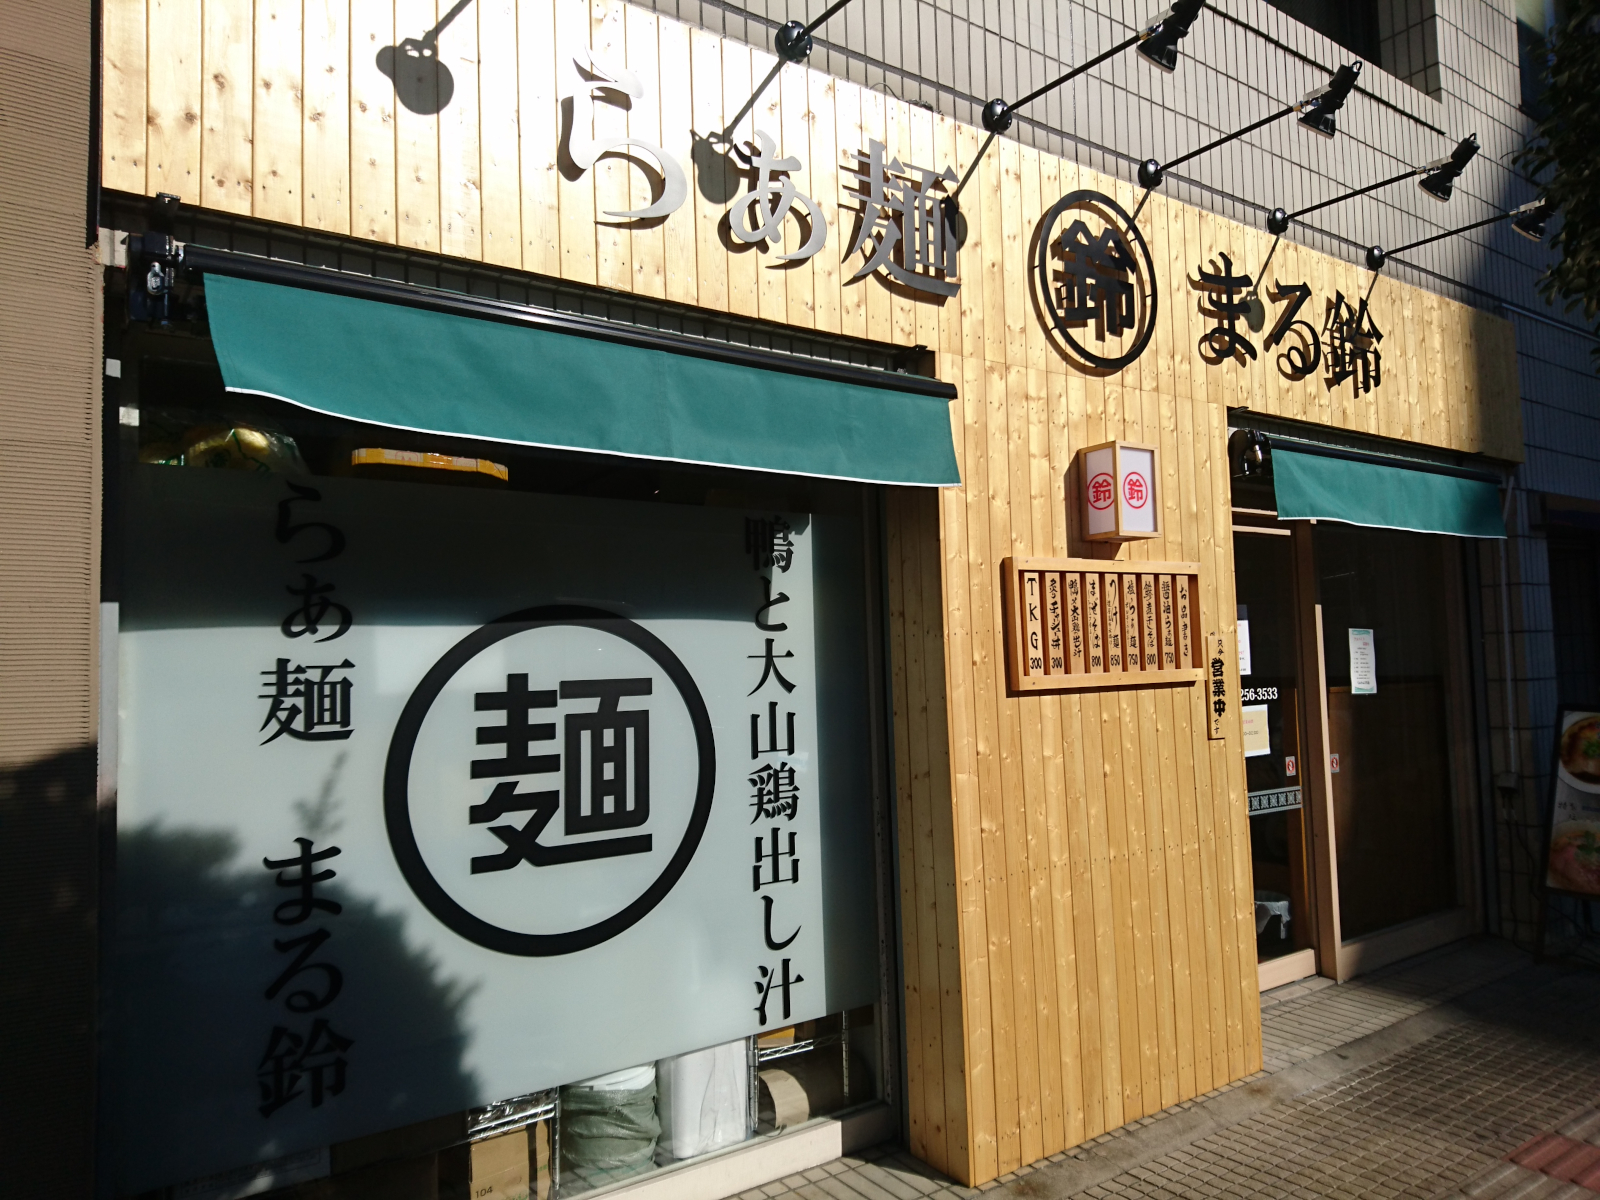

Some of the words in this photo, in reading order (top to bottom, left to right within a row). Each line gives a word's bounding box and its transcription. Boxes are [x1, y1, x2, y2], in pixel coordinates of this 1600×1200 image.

[558, 47, 962, 304] らぁ麺
[1048, 218, 1136, 340] 鈴
[1188, 251, 1384, 398] まる鈴
[257, 481, 356, 746] らぁ麺
[1030, 656, 1042, 670] 300
[1051, 656, 1063, 669] 300
[1091, 655, 1102, 668] 800
[1110, 654, 1121, 667] 850
[1128, 653, 1138, 666] 750
[1146, 653, 1157, 666] 800
[1164, 652, 1175, 664] 750
[469, 673, 653, 875] 麺
[744, 514, 806, 1027] 鴨と大山鶏出し汁
[257, 837, 355, 1118] まる鈴
[475, 1186, 493, 1198] 104
